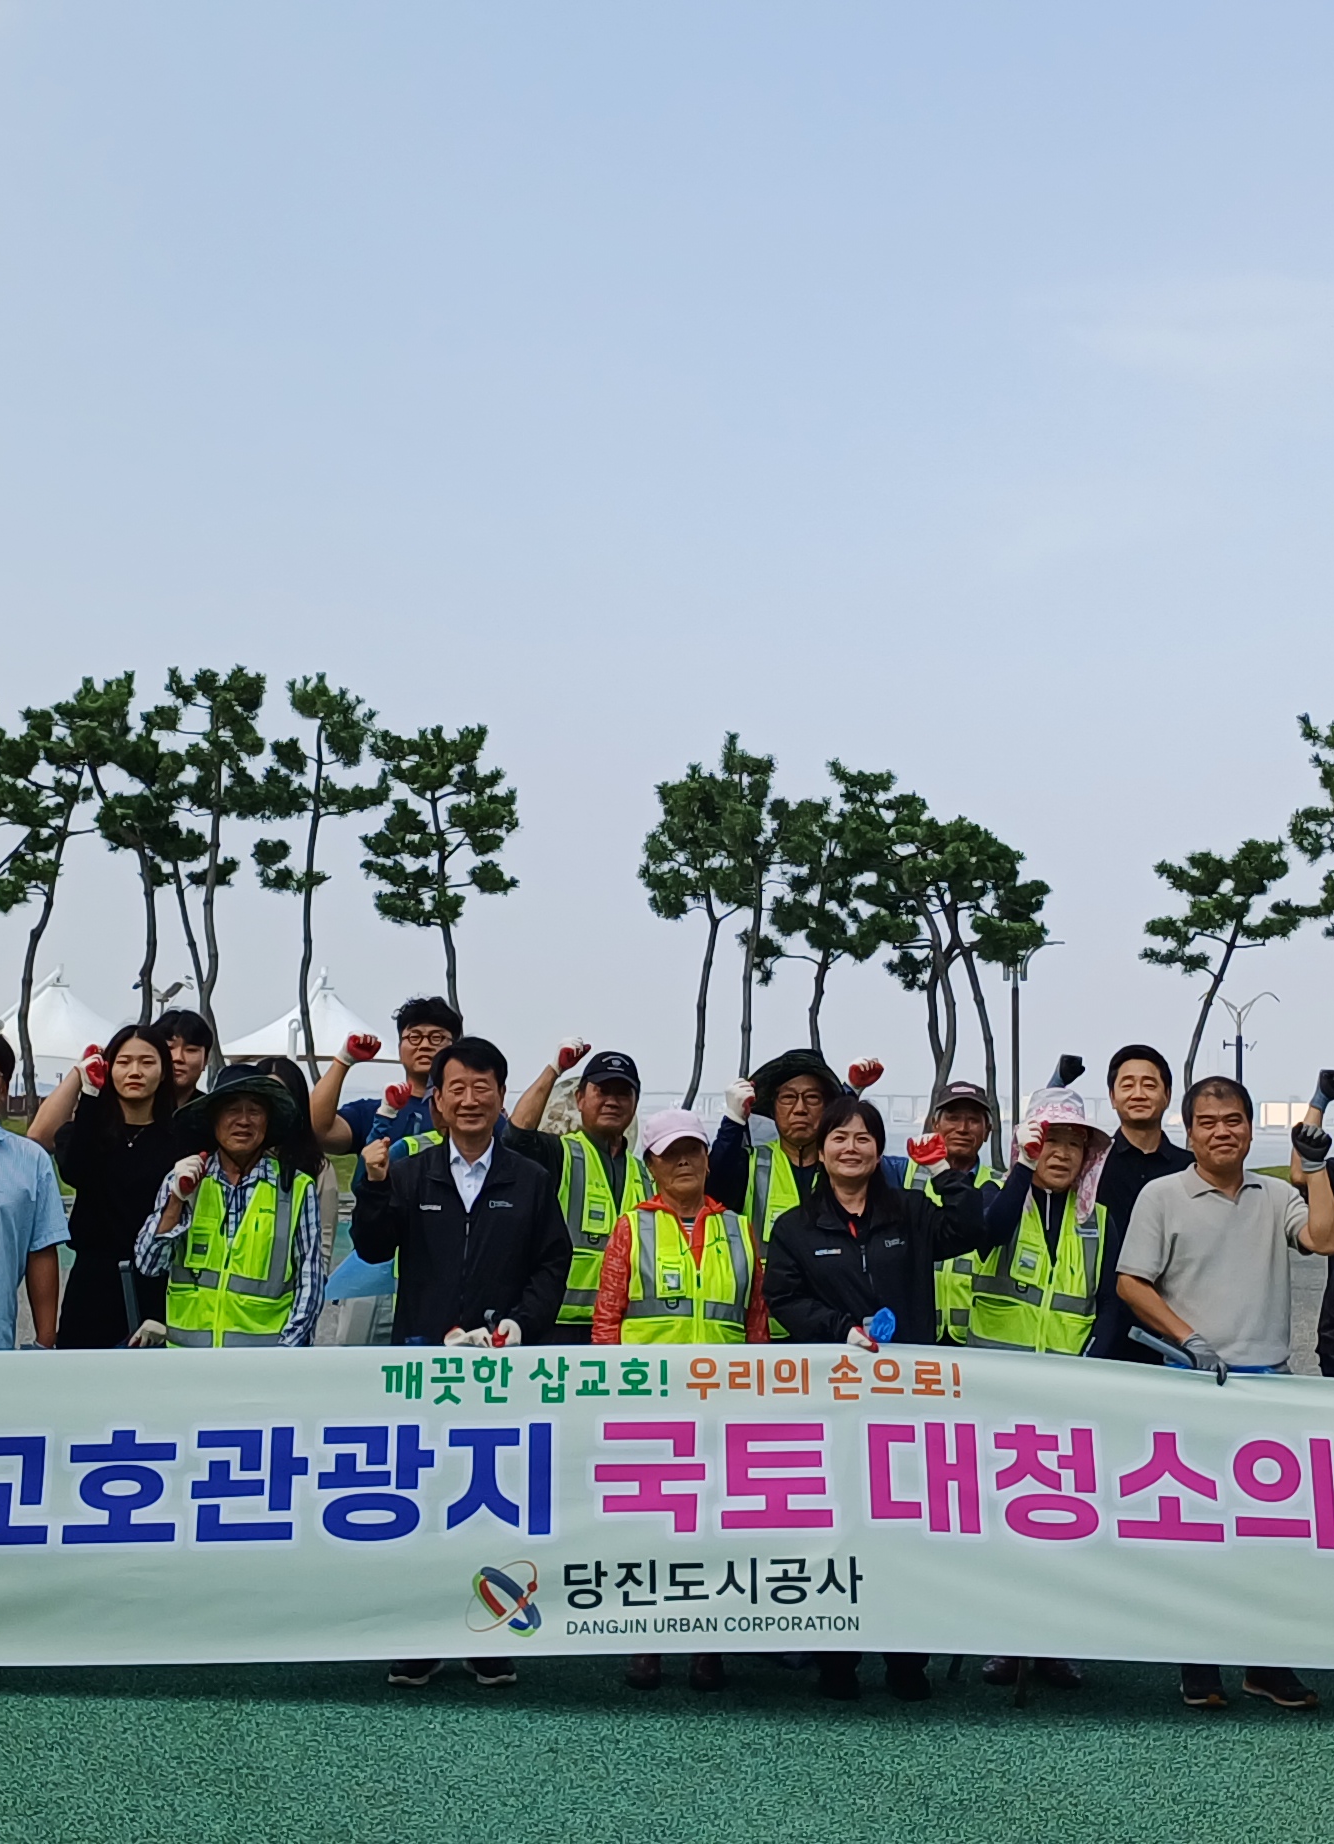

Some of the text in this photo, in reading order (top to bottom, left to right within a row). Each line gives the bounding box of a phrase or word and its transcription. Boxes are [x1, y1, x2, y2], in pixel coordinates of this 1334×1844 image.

[381, 1354, 961, 1404] 깨끗한 삽교호! 우리의 손으로!
[594, 1421, 834, 1533] 국토
[563, 1555, 864, 1610] 당진도시공사
[566, 1615, 860, 1636] DANGJIN URBAN CORPORATION
